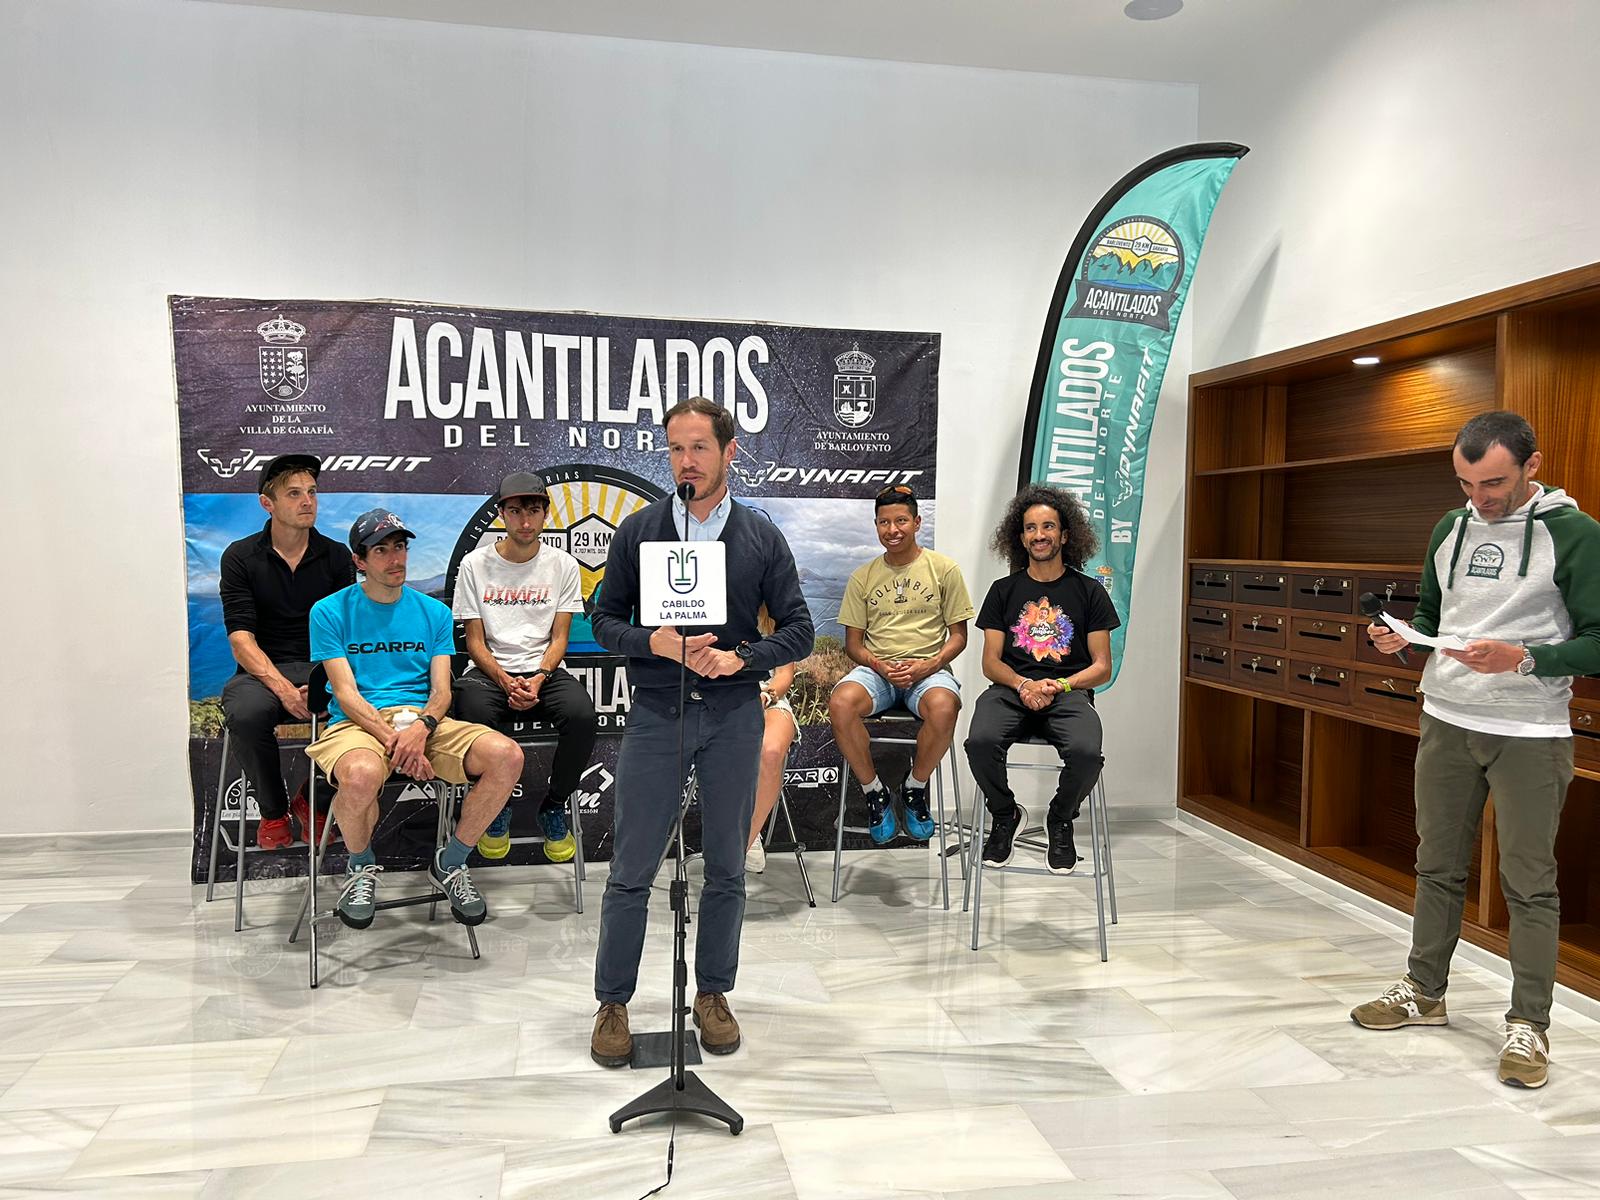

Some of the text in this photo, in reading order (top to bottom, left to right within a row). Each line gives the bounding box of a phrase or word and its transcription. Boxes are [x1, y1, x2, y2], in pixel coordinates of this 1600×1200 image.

[1083, 287, 1162, 317] ACANTILADOS
[1116, 311, 1146, 320] NORTE
[383, 316, 769, 434] ACANTILADOS
[244, 404, 327, 413] AYUNTAMIENTO
[272, 415, 301, 424] DE LA
[239, 424, 334, 435] VILLA DE GARAFÍA
[816, 431, 890, 441] AYUNTAMIENTO
[443, 424, 656, 452] DEL NOR
[1111, 345, 1154, 543] BY DYNAFIT
[814, 441, 892, 453] DE BARLOVENTO
[1093, 374, 1122, 519] DEL NORTE
[767, 467, 924, 486] DYNAFIT
[574, 531, 590, 547] 29
[593, 531, 612, 547] KM
[483, 583, 553, 602] DYNAFIT
[869, 577, 935, 606] COLUMBIA
[661, 599, 705, 608] CABILDO
[659, 611, 708, 620] LA PALMA
[346, 641, 427, 655] SCARPA
